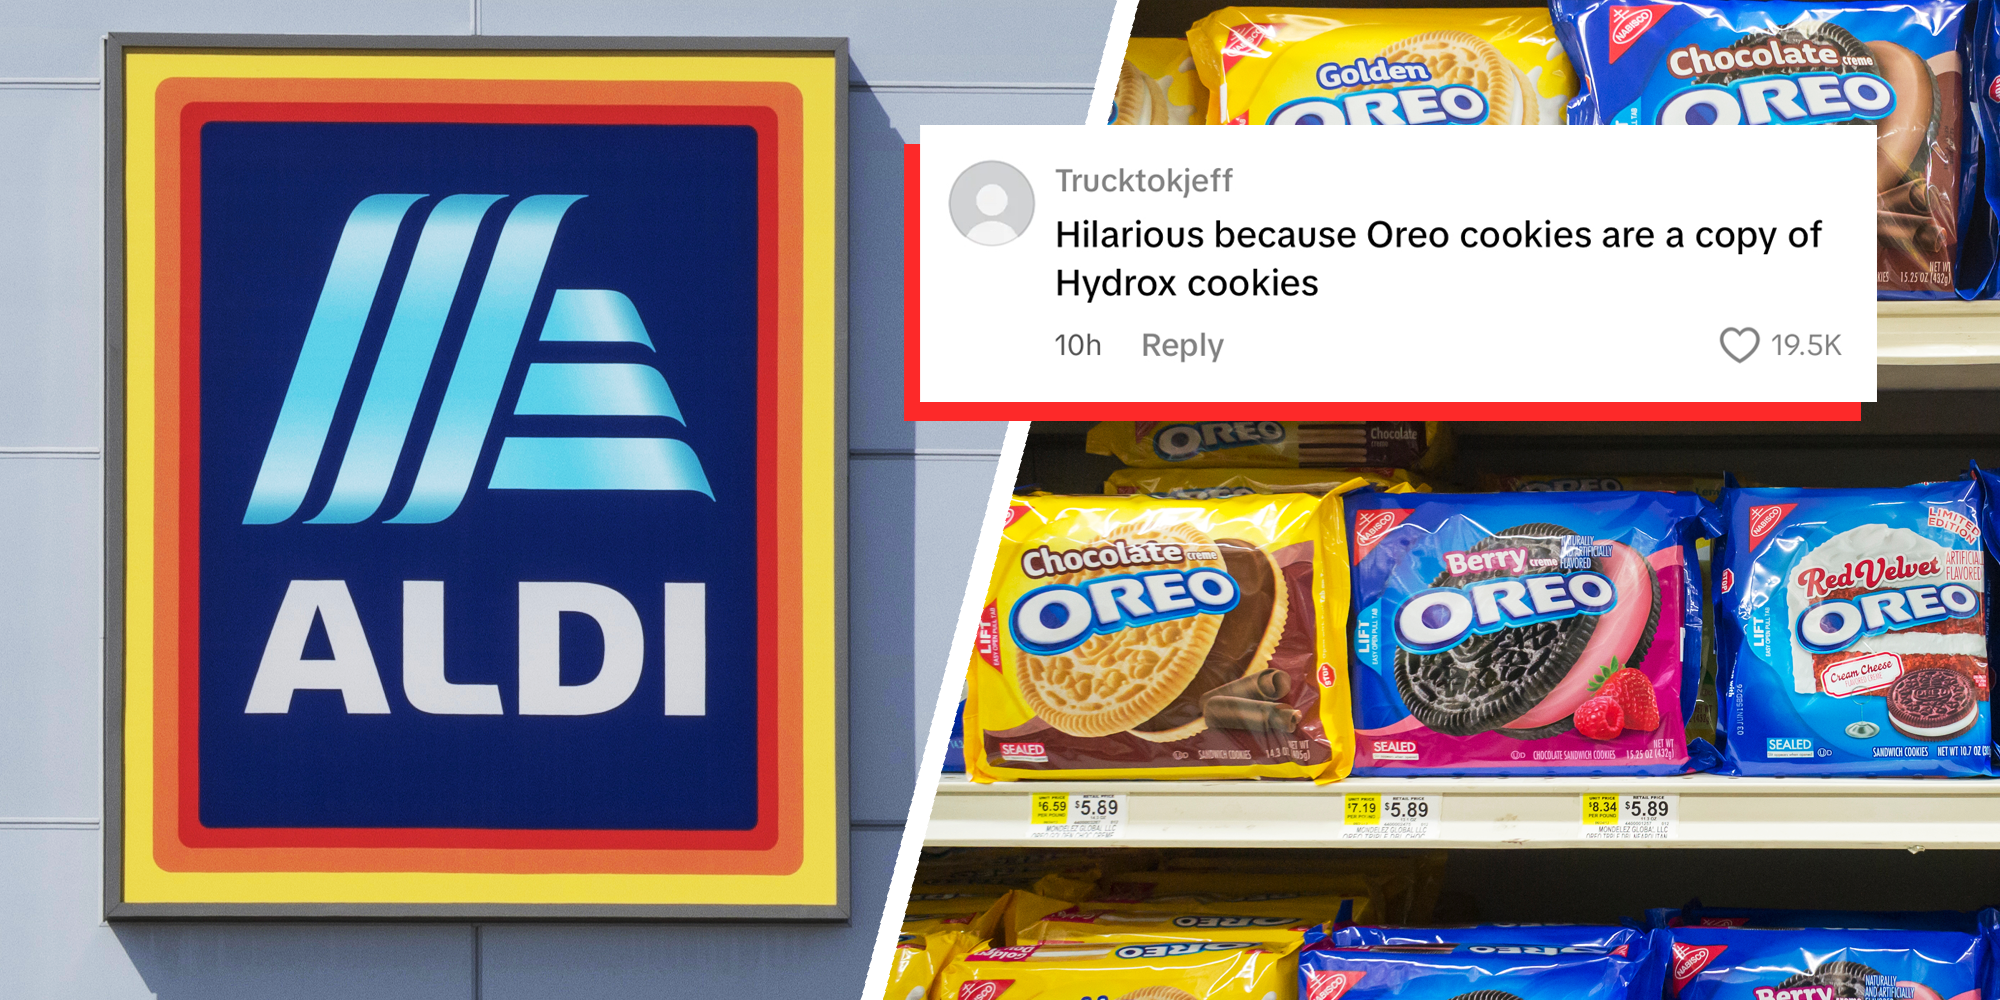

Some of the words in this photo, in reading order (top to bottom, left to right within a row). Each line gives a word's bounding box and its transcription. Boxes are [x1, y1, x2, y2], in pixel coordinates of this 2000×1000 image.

[1615, 12, 1649, 42] NABISCO
[1669, 40, 1838, 76] Chocolate
[1842, 54, 1874, 66] creme
[1319, 57, 1429, 88] Golden
[1661, 76, 1890, 125] OREO
[1900, 272, 1918, 283] 15.25
[1920, 272, 1929, 283] OZ
[1930, 272, 1951, 287] (432g)
[1157, 421, 1283, 460] OREO
[1370, 427, 1418, 440] Chocolate
[1359, 514, 1392, 543] NABISCO
[1753, 508, 1779, 535] NABISCO
[1928, 517, 1976, 544] EDITION
[1929, 507, 1980, 536] LIMITED
[1023, 541, 1183, 577] Chocolate
[1187, 550, 1218, 560] creme
[1446, 549, 1526, 574] Berry
[1529, 558, 1558, 567] creme
[1560, 557, 1592, 569] FLAVORED
[1798, 562, 1855, 597] Red
[1854, 556, 1941, 588] Velvet
[1946, 566, 1982, 580] FLAVORED
[1018, 571, 1234, 645] OREO
[1400, 574, 1613, 644] OREO
[1802, 585, 1976, 645] OREO
[980, 621, 992, 654] LIFT
[1358, 620, 1370, 653] LIFT
[1753, 616, 1764, 647] LIFT
[245, 580, 706, 716] ALDI
[1322, 665, 1332, 686] STOP
[1830, 671, 1860, 684] Cream
[1860, 660, 1893, 675] Cheese
[1002, 744, 1045, 755] SEALED
[1373, 741, 1417, 752] SEALED
[1653, 739, 1664, 749] NET
[1665, 738, 1674, 748] WT
[1769, 739, 1812, 750] SEALED
[1872, 747, 1903, 757] SANDWICH
[1904, 747, 1929, 757] COOKIES
[1937, 746, 1948, 757] NET
[1949, 746, 1958, 756] WT
[1960, 746, 1972, 756] 10.7
[1973, 745, 1981, 756] OZ
[1198, 750, 1228, 760] SANDWICH
[1533, 750, 1563, 760] CHOCOLATE
[1564, 750, 1592, 760] SANDWICH
[1593, 750, 1616, 760] COOKIES
[1626, 750, 1644, 760] 15.25
[1644, 749, 1653, 759] OZ
[1654, 748, 1675, 761] (432g)
[1038, 801, 1067, 812] $6.59
[1075, 799, 1118, 816] $5.89
[1347, 803, 1376, 813] $7.19
[1385, 802, 1429, 818] $5.89
[1588, 801, 1617, 812] $8.34
[1625, 801, 1669, 817] $5.89
[1175, 917, 1302, 928] OREO
[1117, 943, 1259, 958] OREO
[1676, 950, 1706, 977] NABISCO
[1865, 975, 1897, 986] NATURALLY
[1865, 987, 1878, 998] AND
[1878, 987, 1915, 998] ARTIFICIALLY
